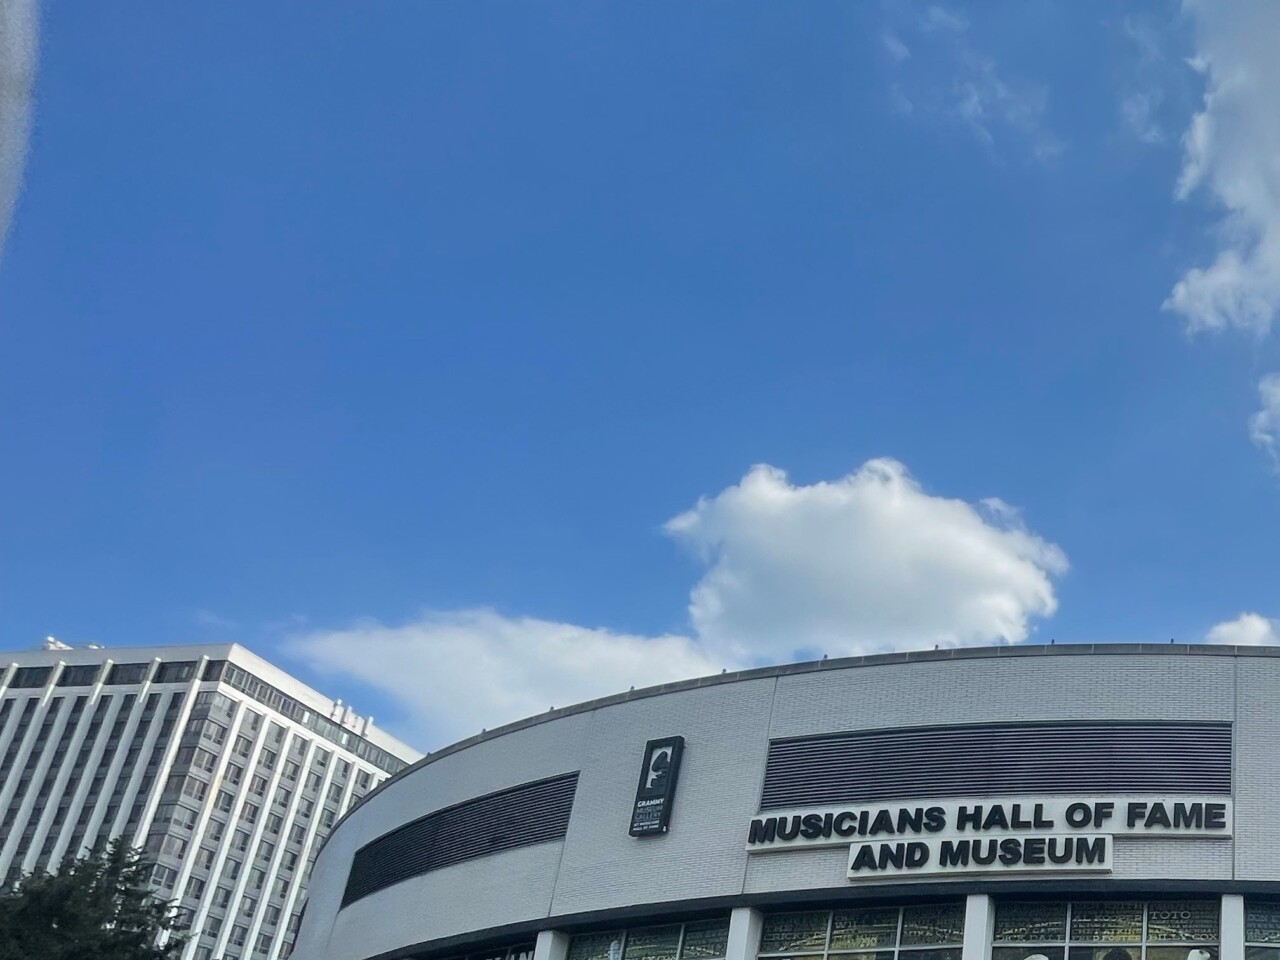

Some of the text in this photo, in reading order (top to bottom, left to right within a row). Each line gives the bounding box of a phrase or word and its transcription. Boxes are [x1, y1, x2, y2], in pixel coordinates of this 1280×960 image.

[637, 798, 664, 808] GRAMMY
[748, 802, 1226, 844] MUSICIANS HALL OF FAME
[851, 837, 1106, 871] AND MUSEUM
[1149, 911, 1191, 919] TOTO
[1191, 933, 1217, 941] COX
